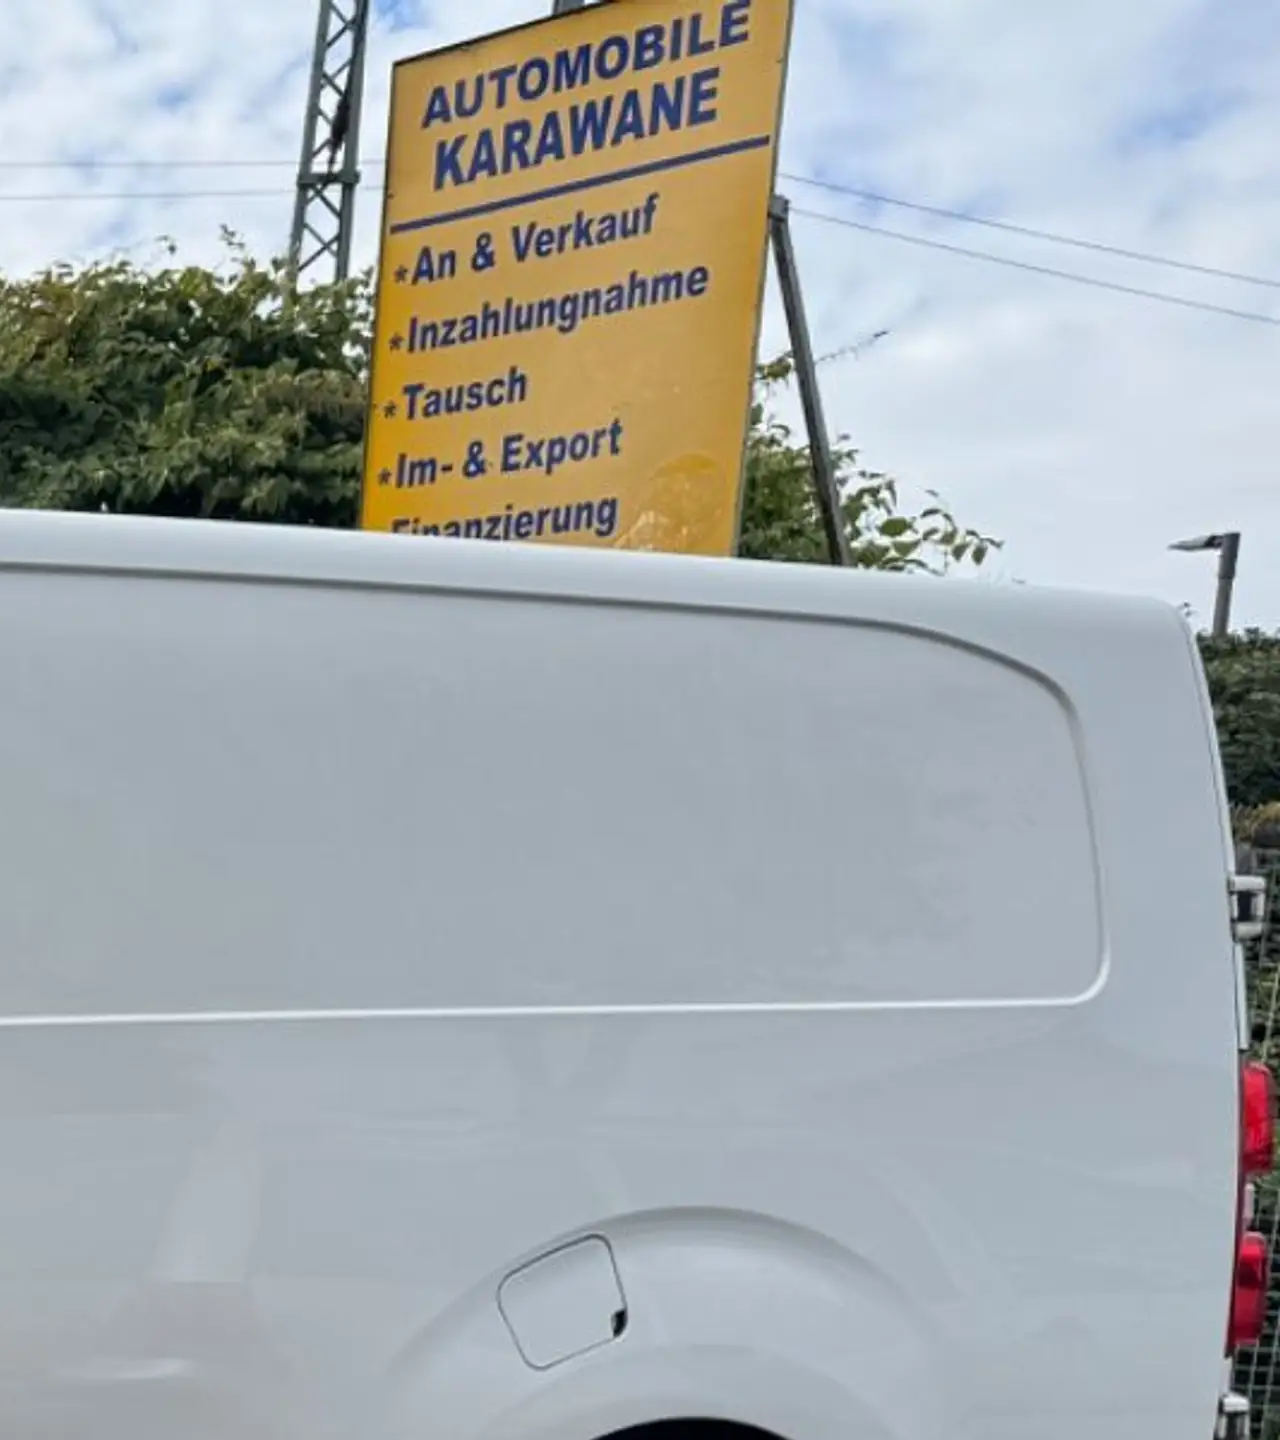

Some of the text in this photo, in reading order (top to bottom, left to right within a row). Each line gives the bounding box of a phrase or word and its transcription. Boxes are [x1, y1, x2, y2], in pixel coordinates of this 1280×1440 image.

[420, 1, 751, 129] AUTOMOBILE
[433, 66, 721, 191] KARAWANE
[411, 191, 661, 285] An & Verkauf
[406, 264, 710, 354] Inzahlungnahme
[402, 365, 528, 421] Tausch
[395, 417, 624, 489] Im- & Export
